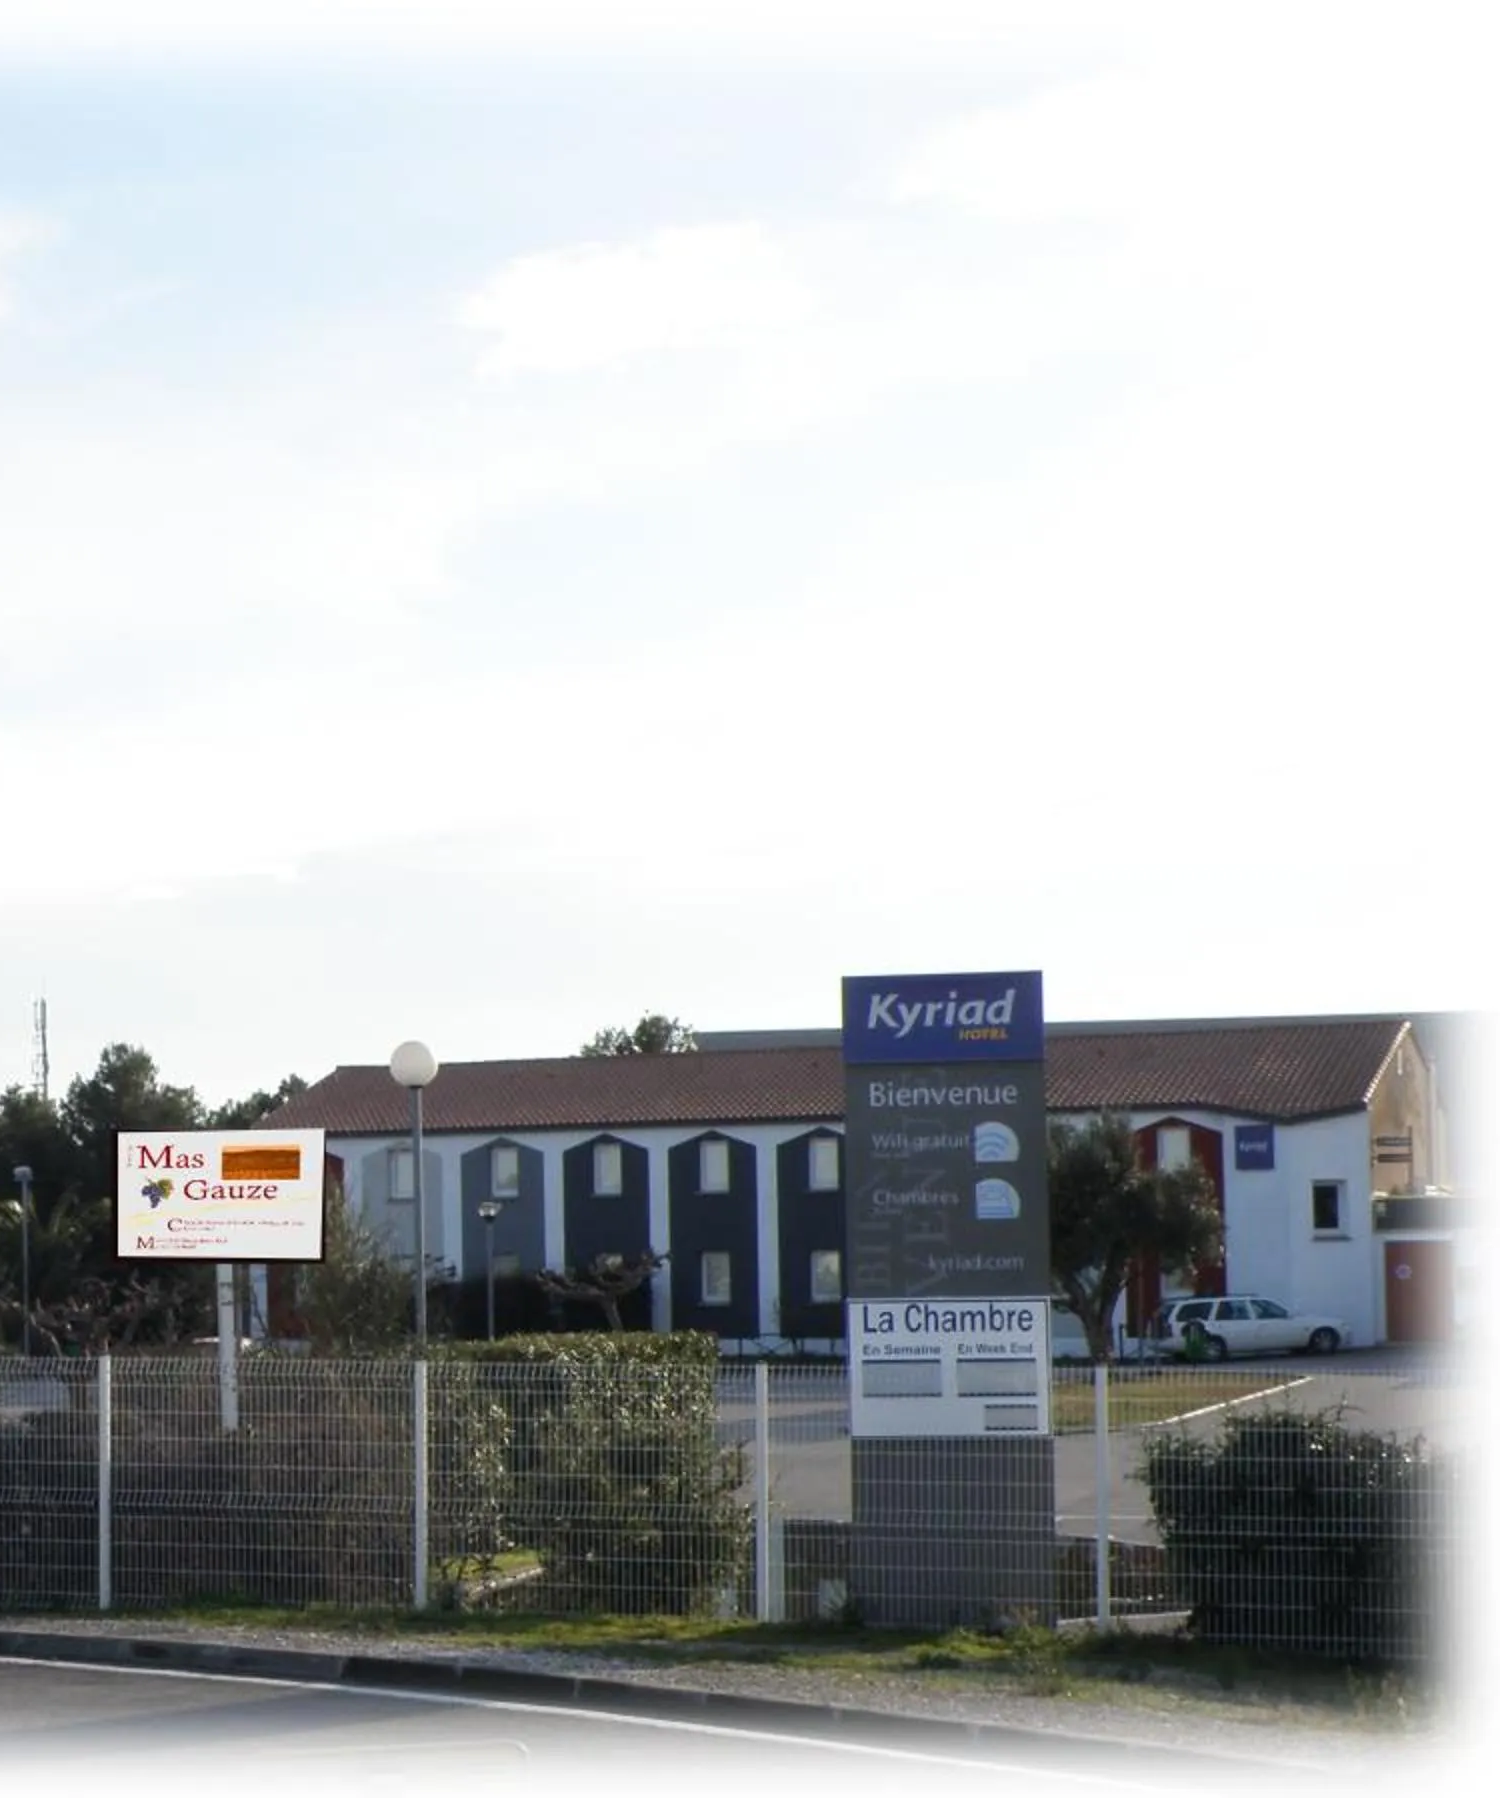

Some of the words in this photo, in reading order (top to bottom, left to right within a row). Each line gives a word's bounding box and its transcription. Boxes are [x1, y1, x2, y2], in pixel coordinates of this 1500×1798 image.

[868, 989, 1016, 1038] Kyriad
[959, 1028, 1007, 1040] HOTEL
[869, 1082, 1018, 1107] Bienvenue
[136, 1144, 205, 1169] Mas
[183, 1179, 278, 1201] Gauze
[863, 1304, 894, 1333] La
[905, 1303, 1033, 1333] Chambre
[863, 1344, 881, 1355] En
[884, 1344, 941, 1356] Semaine
[958, 1343, 973, 1354] En
